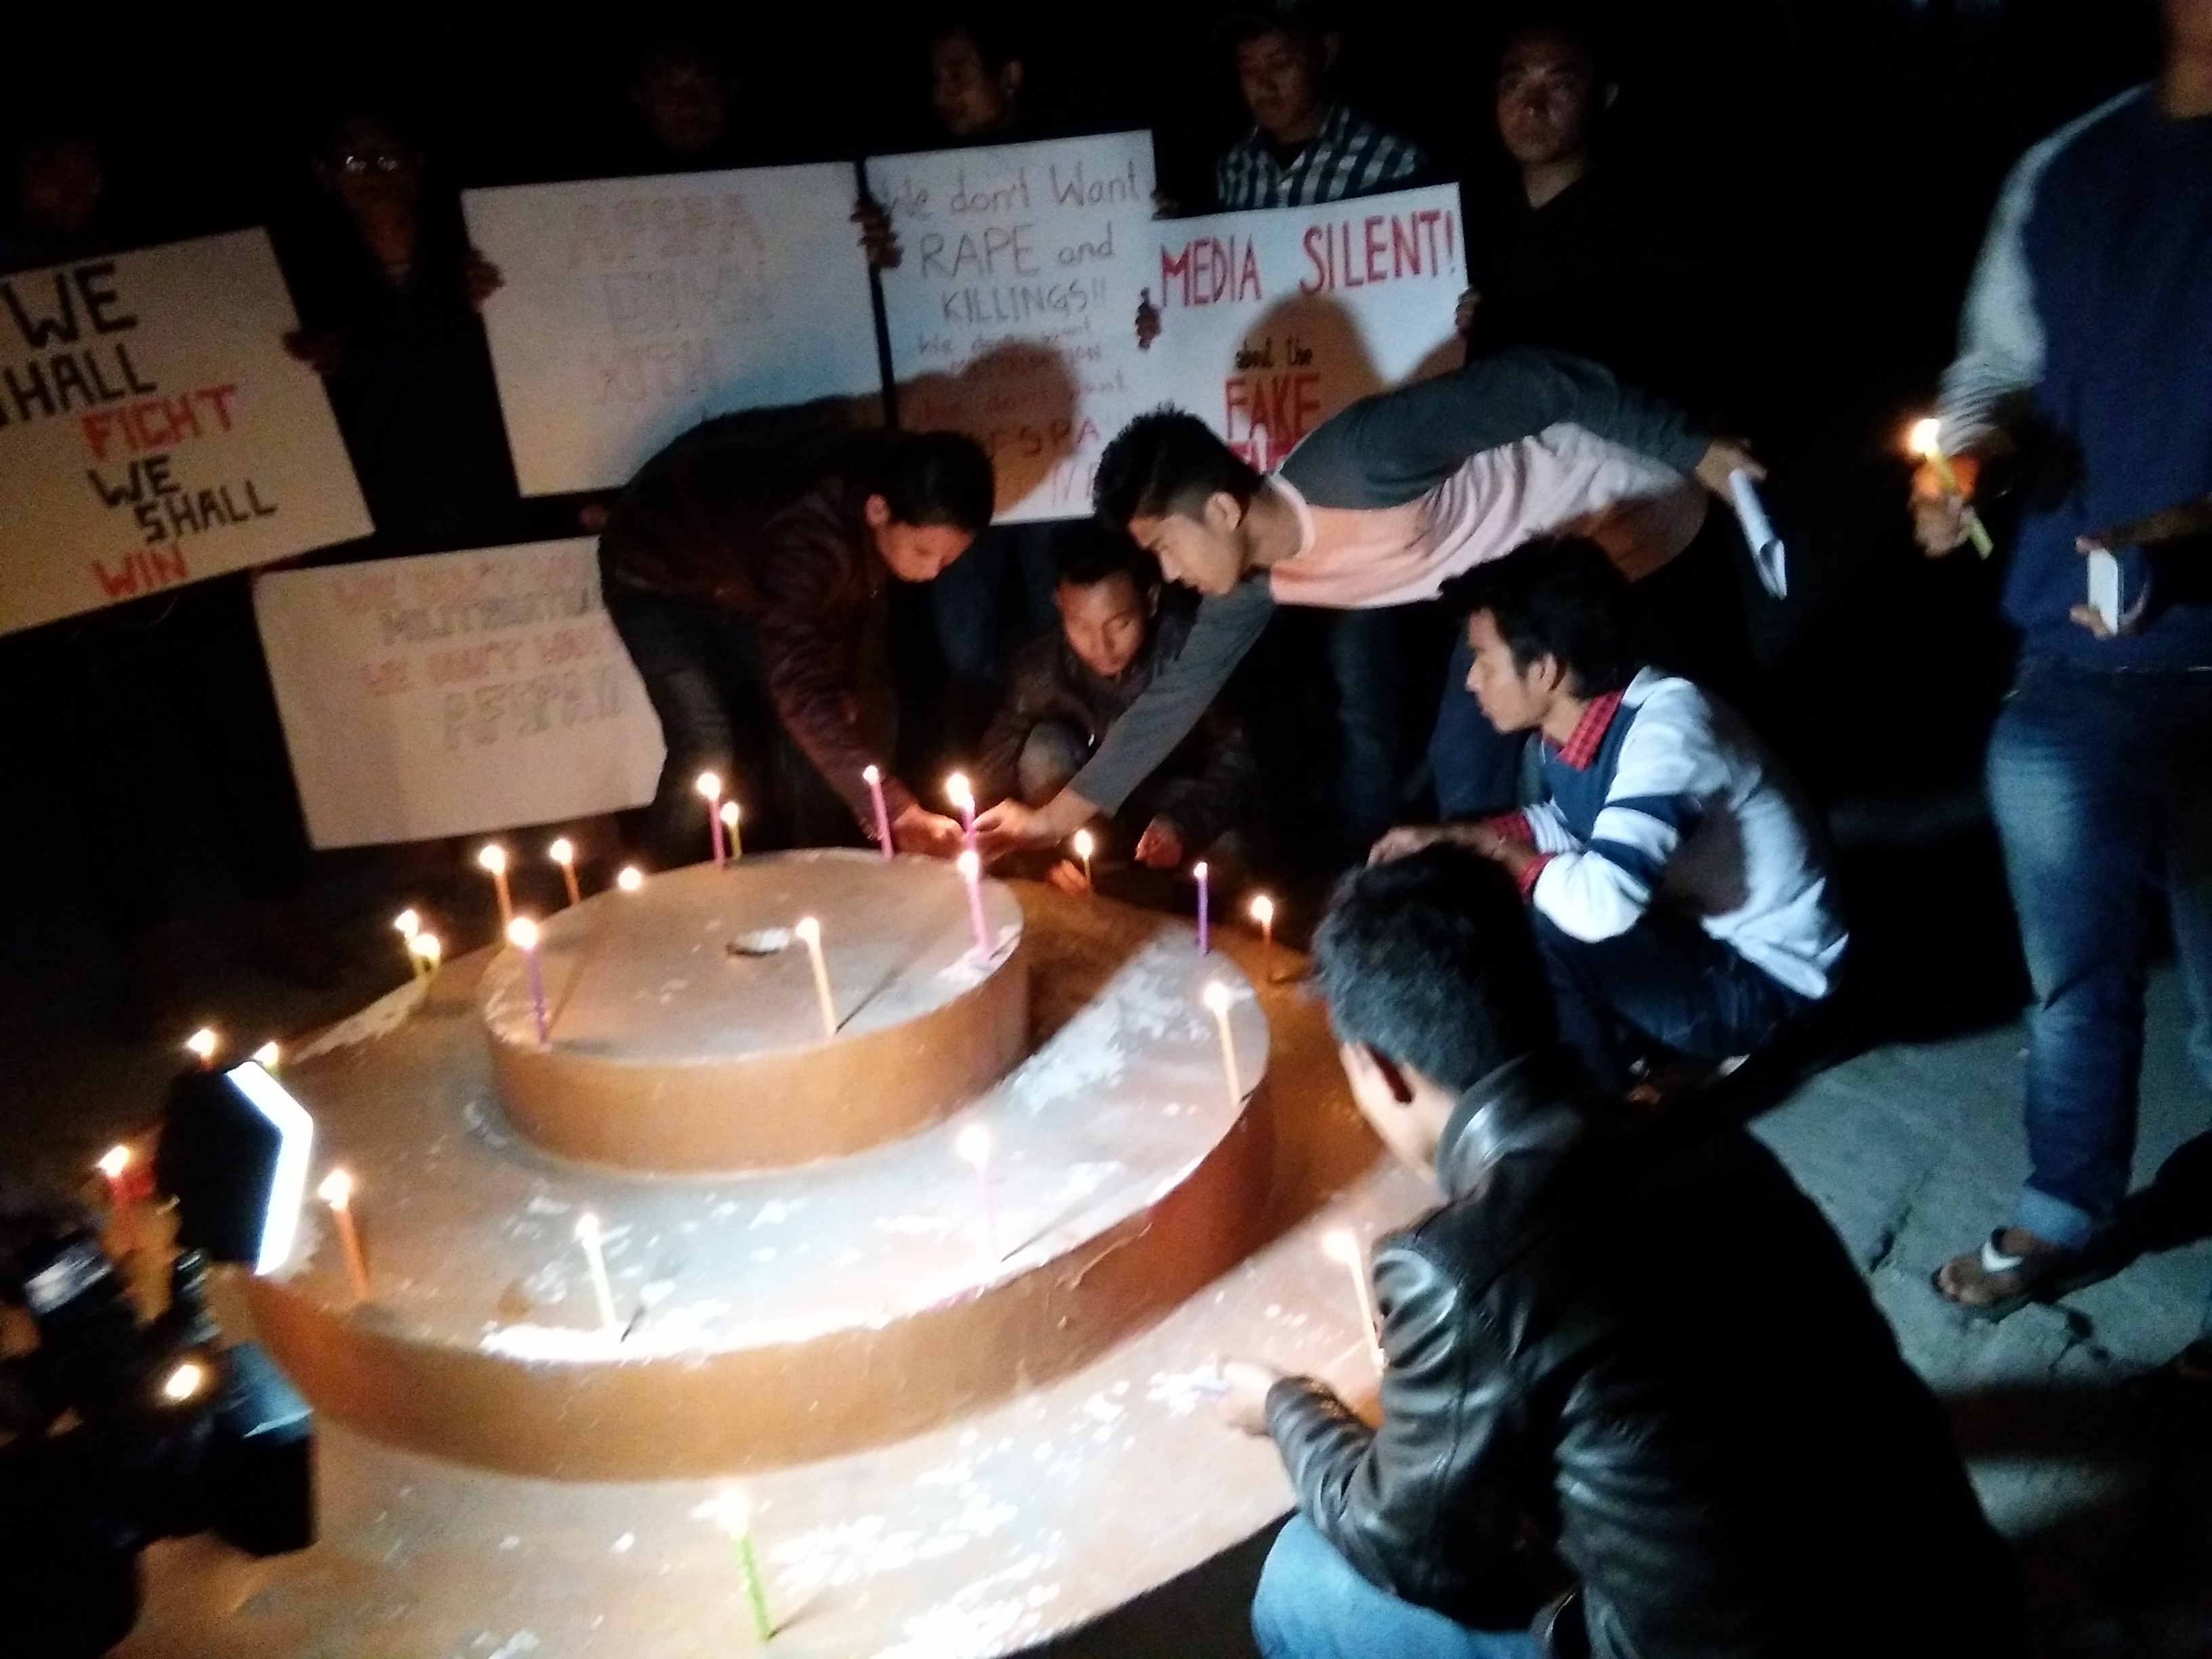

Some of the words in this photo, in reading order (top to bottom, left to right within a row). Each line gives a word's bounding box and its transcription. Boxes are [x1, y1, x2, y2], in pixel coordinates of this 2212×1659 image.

[919, 224, 1042, 279] RAPE
[1059, 220, 1115, 266] and
[1160, 234, 1263, 308] MEDIA
[1300, 209, 1455, 295] SILENT!
[1, 261, 138, 350] WE
[0, 343, 157, 425] HALL
[1225, 373, 1321, 442] FAKE
[82, 384, 236, 462] FIGHT
[87, 455, 180, 506] WE
[135, 480, 278, 545] SHALL
[90, 544, 189, 596] WIN
